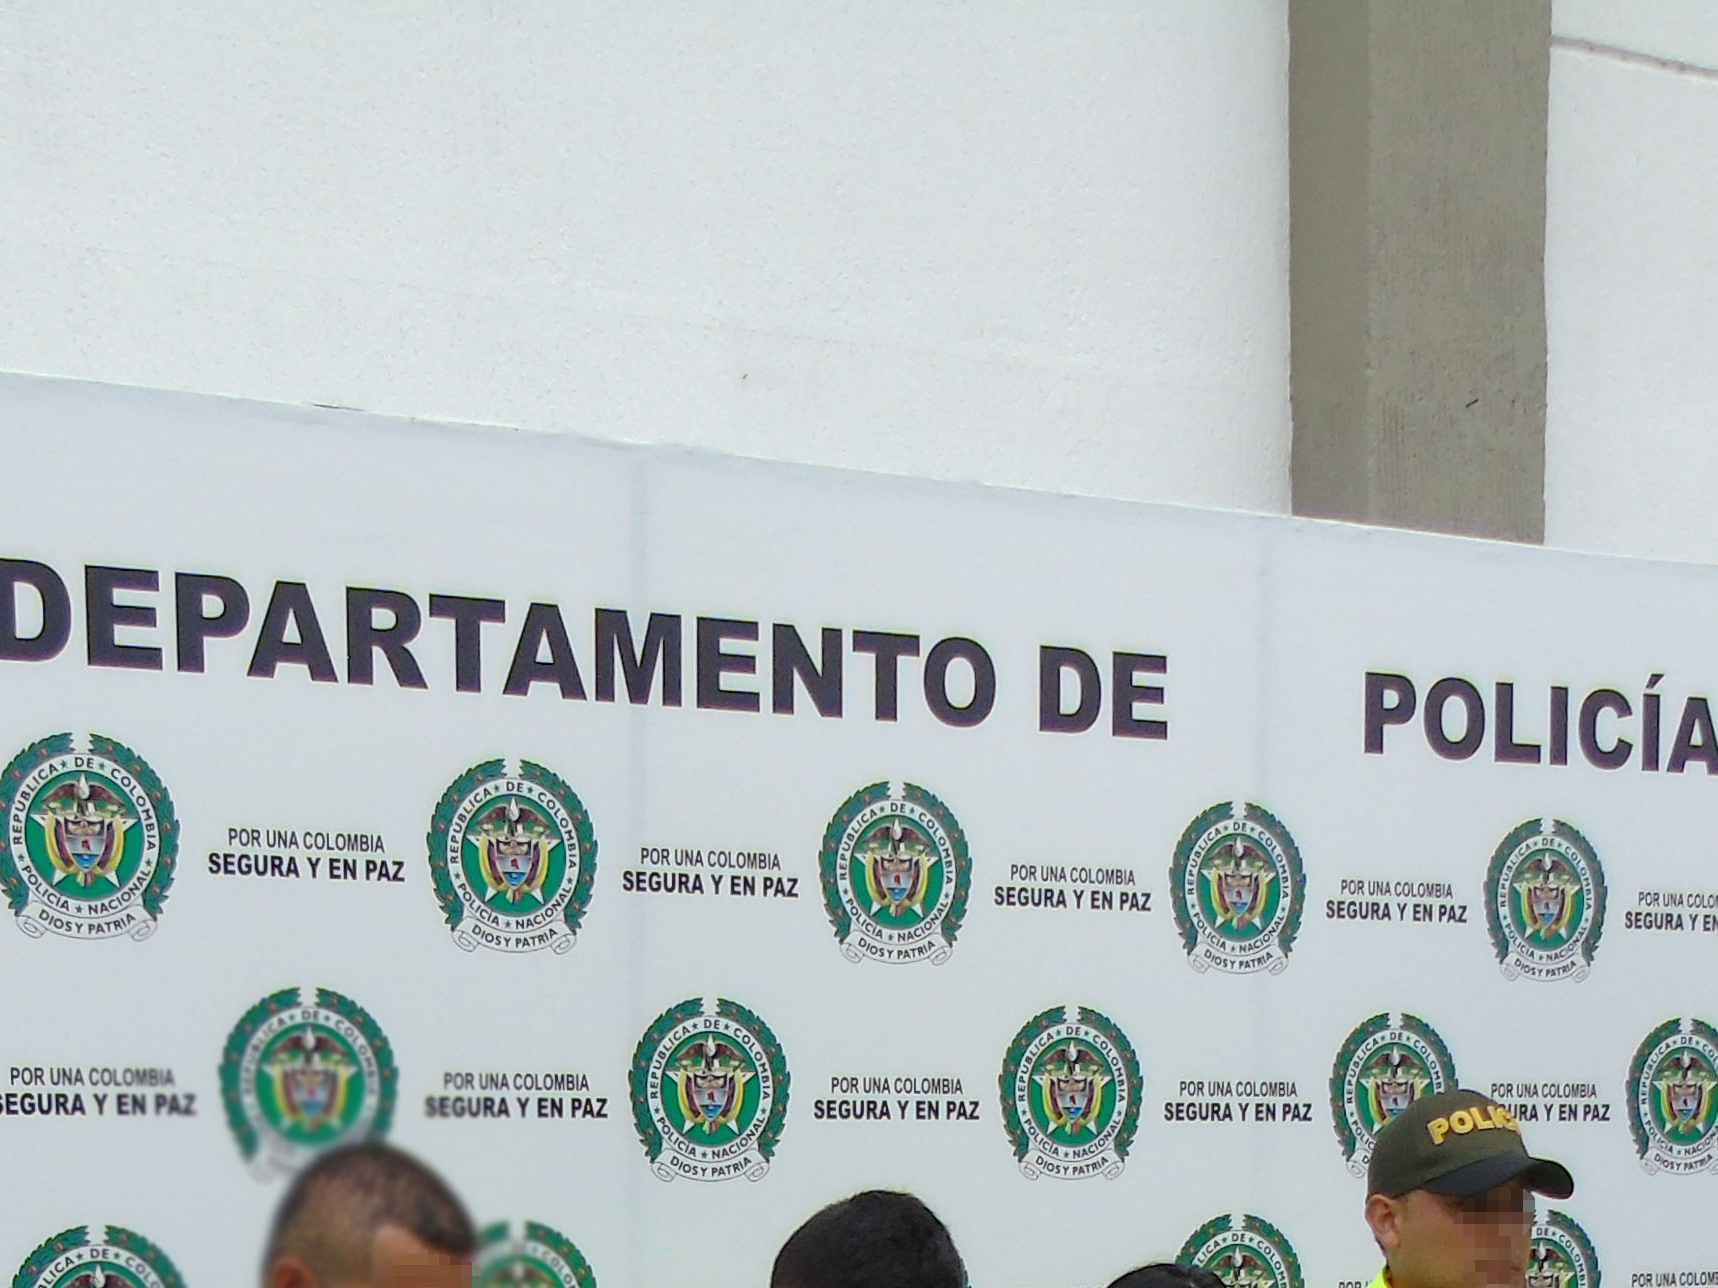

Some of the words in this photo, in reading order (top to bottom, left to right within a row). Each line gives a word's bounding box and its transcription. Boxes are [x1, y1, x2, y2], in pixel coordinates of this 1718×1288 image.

[1040, 645, 1167, 739] DE
[74, 757, 94, 769] DE
[110, 769, 157, 851] COLOMBIA
[506, 782, 524, 793] DE
[538, 791, 577, 869] COLOMBIA
[229, 828, 261, 847] POR
[267, 830, 299, 849] UNA
[303, 832, 384, 853] COLOMBIA
[209, 853, 299, 878] SEGURA
[307, 857, 321, 878] Y
[329, 858, 356, 880] EN
[366, 860, 404, 882] PAZ
[641, 848, 670, 865] POR
[675, 849, 703, 866] UNA
[708, 851, 780, 870] COLOMBIA
[623, 871, 704, 894] SEGURA
[711, 874, 723, 894] Y
[731, 875, 755, 896] EN
[763, 877, 798, 898] PAZ
[1011, 864, 1036, 881] POR
[1041, 866, 1067, 882] UNA
[1070, 867, 1135, 885] COLOMBIA
[88, 870, 152, 916] NACIONAL
[995, 886, 1067, 908] SEGURA
[1073, 890, 1084, 909] Y
[1091, 890, 1113, 910] EN
[1120, 892, 1151, 911] PAZ
[1341, 880, 1364, 895] POR
[1368, 881, 1391, 896] UNA
[1395, 882, 1452, 899] COLOMBIA
[1639, 892, 1659, 906] POR
[1663, 894, 1683, 907] UNA
[515, 887, 572, 931] NACIONAL
[1326, 900, 1391, 920] SEGURA
[1397, 903, 1407, 921] Y
[1413, 904, 1433, 922] EN
[1439, 904, 1467, 923] PAZ
[88, 913, 136, 935] PATRIA
[1625, 911, 1684, 930] SEGURA
[1689, 914, 1698, 931] Y
[516, 928, 558, 948] PATRIA
[11, 1067, 45, 1085] POR
[50, 1068, 84, 1085] UNA
[89, 1068, 173, 1086] COLOMBIA
[444, 1073, 474, 1089] POR
[480, 1074, 509, 1090] UNA
[514, 1073, 589, 1091] COLOMBIA
[832, 1077, 859, 1093] POR
[864, 1078, 890, 1094] UNA
[895, 1078, 963, 1094] COLOMBIA
[1180, 1081, 1204, 1096] POR
[1209, 1081, 1233, 1096] UNA
[1236, 1081, 1297, 1097] COLOMBIA
[1491, 1083, 1513, 1098] POR
[1517, 1084, 1538, 1098] UNA
[1542, 1083, 1596, 1098] COLOMBIA
[93, 1094, 108, 1115] Y
[116, 1094, 146, 1115] EN
[155, 1094, 195, 1116] PAZ
[426, 1096, 510, 1117] SEGURA
[517, 1097, 529, 1117] Y
[538, 1098, 563, 1118] EN
[571, 1098, 608, 1118] PAZ
[814, 1100, 891, 1119] SEGURA
[897, 1100, 909, 1119] Y
[916, 1101, 939, 1120] EN
[947, 1101, 979, 1120] PAZ
[1164, 1102, 1233, 1121] SEGURA
[1238, 1103, 1249, 1121] Y
[1255, 1103, 1276, 1121] EN
[1283, 1103, 1312, 1121] PAZ
[1544, 1104, 1553, 1121] Y
[1559, 1104, 1577, 1121] EN
[1583, 1104, 1610, 1121] PAZ
[1632, 1273, 1652, 1287] POR
[1656, 1273, 1676, 1287] UNA
